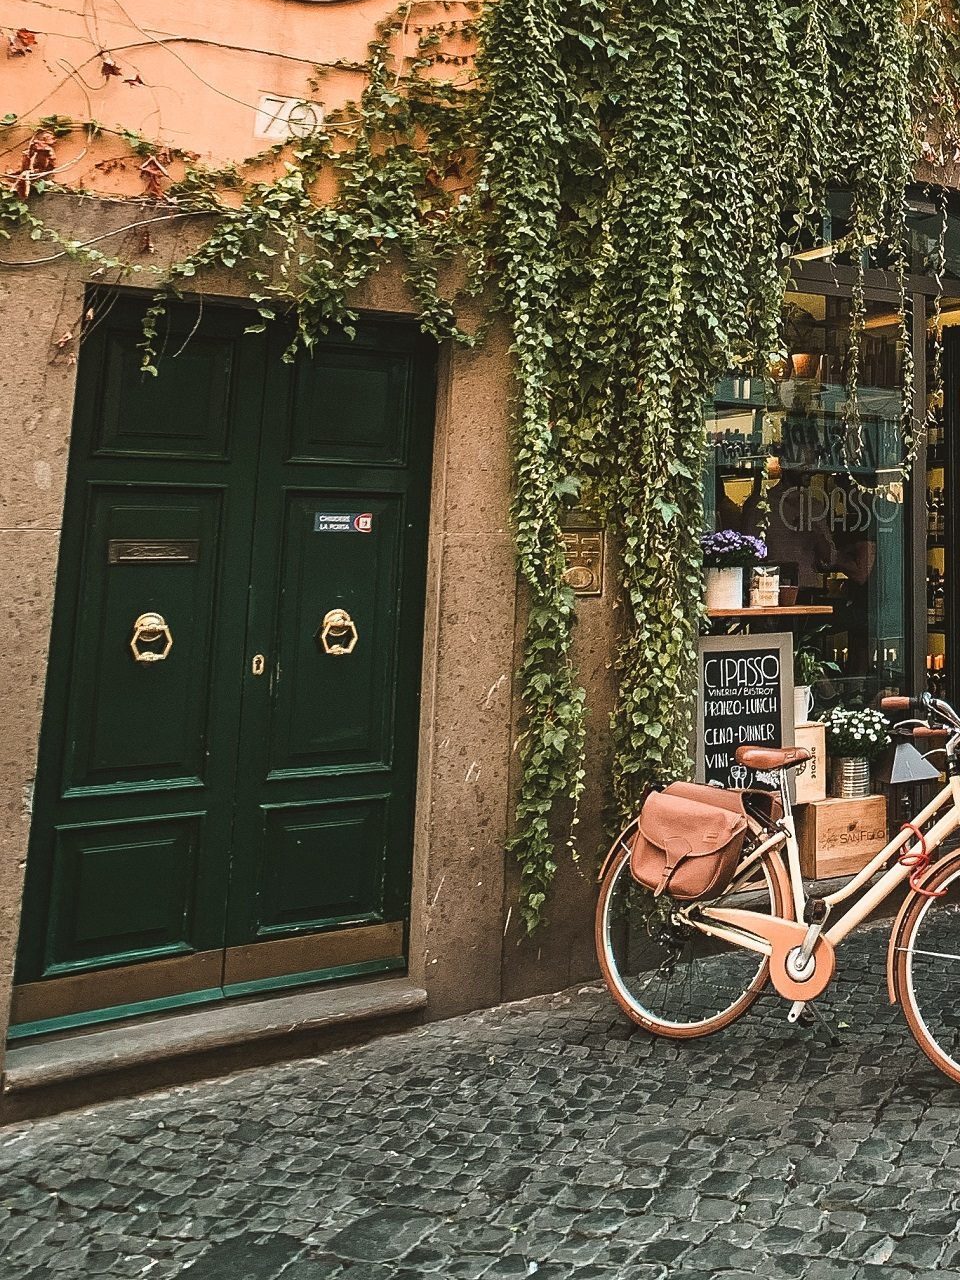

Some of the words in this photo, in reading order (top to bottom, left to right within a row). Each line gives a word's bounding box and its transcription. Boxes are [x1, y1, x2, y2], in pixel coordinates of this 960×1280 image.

[778, 486, 900, 533] CIPASSO
[704, 655, 780, 688] CIPASSO
[704, 723, 775, 746] CENA-DINNER
